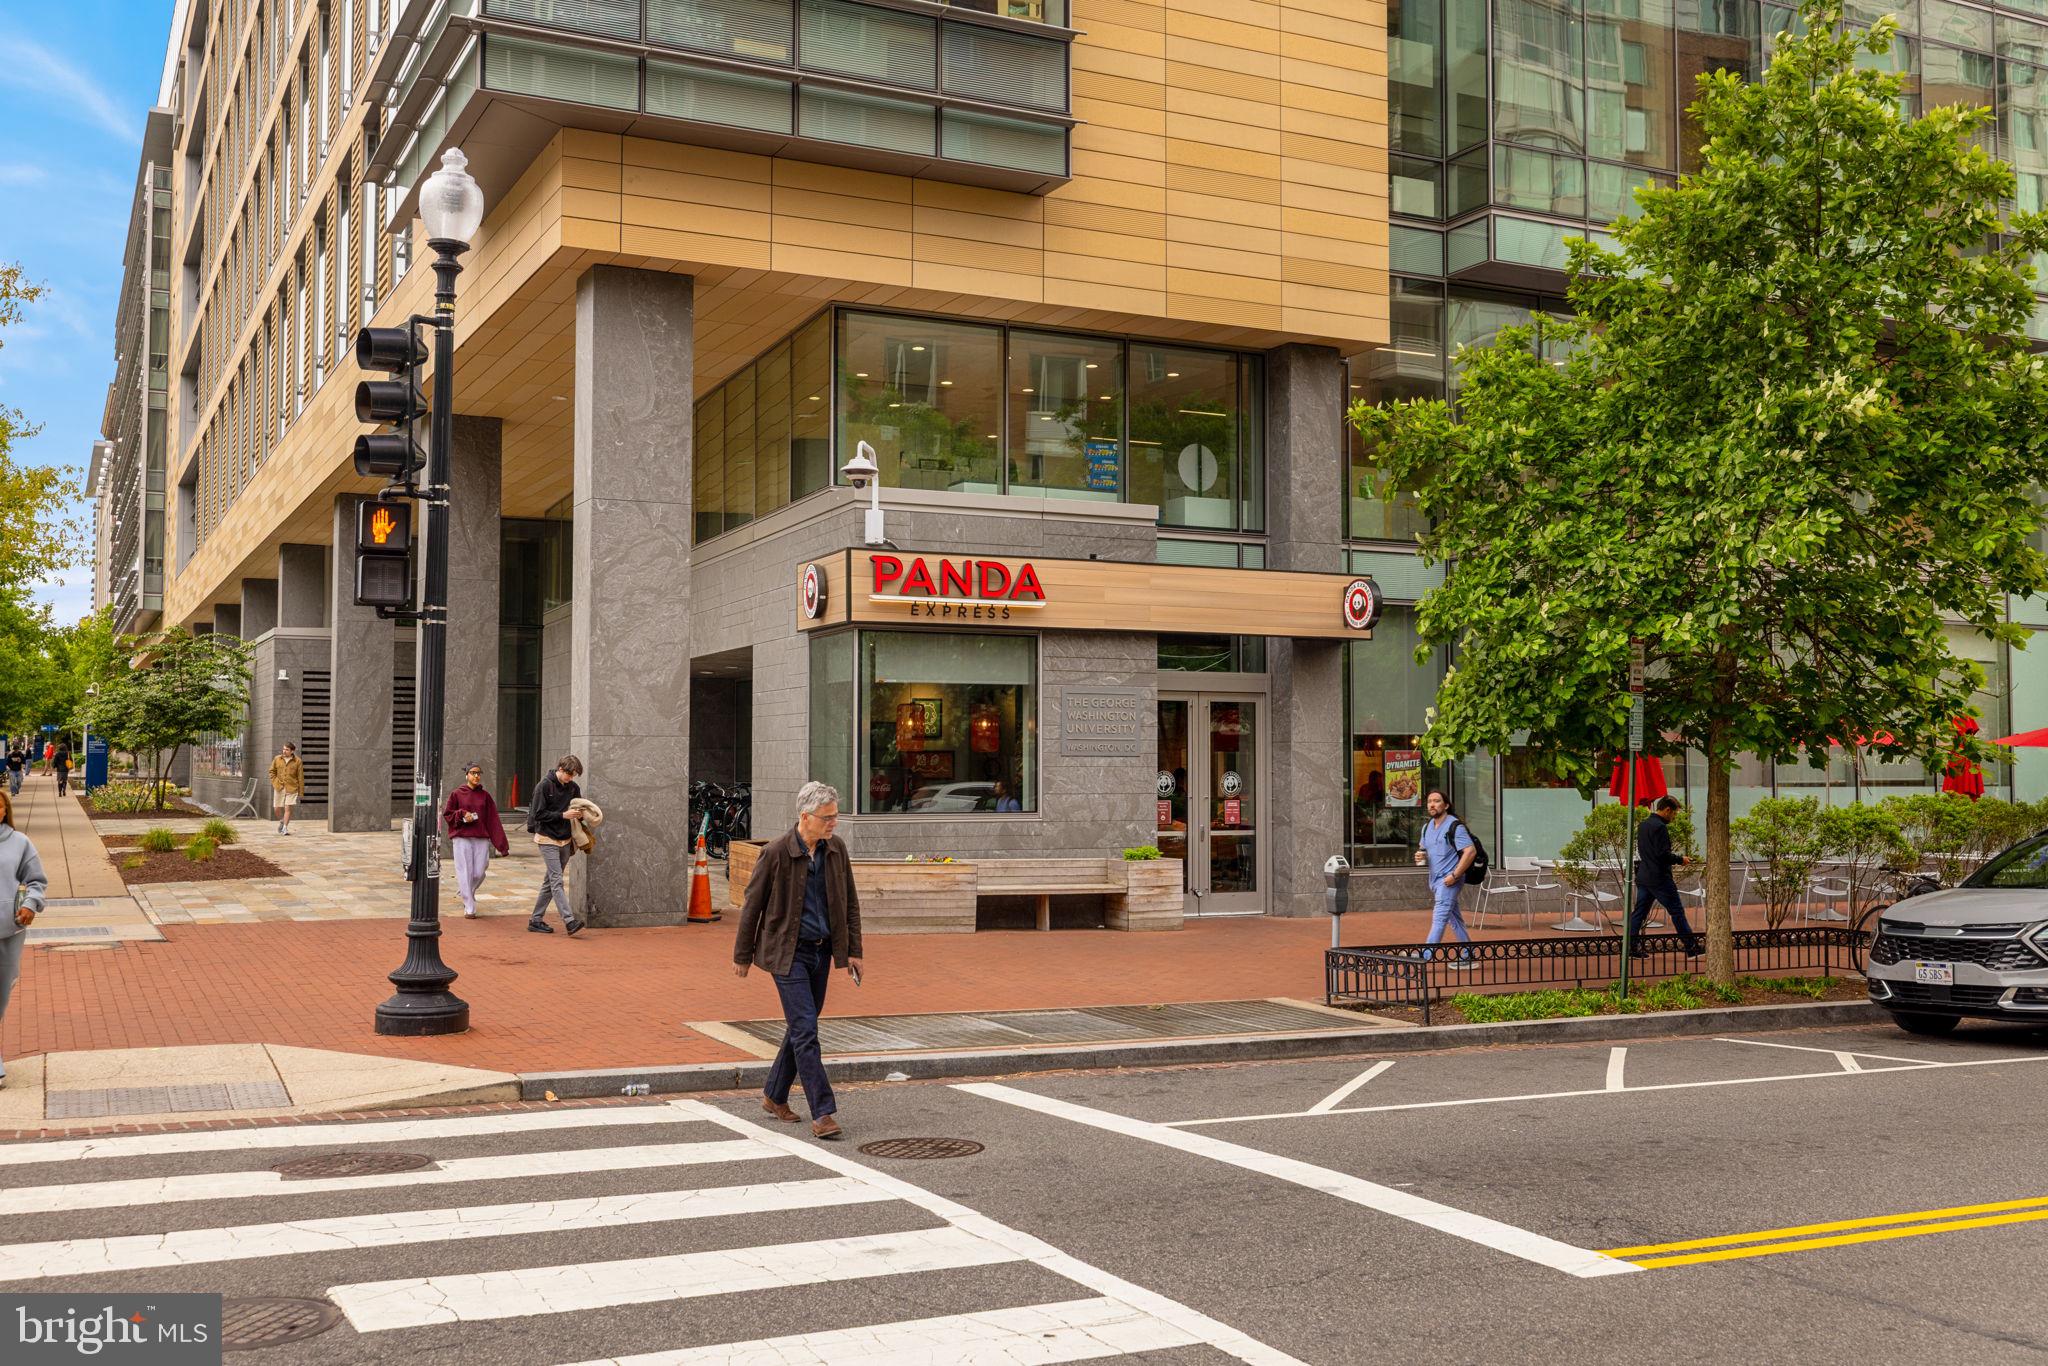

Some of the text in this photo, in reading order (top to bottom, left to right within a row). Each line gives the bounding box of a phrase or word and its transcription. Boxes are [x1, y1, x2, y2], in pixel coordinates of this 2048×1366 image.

[869, 555, 1046, 600] PANDA
[910, 602, 1010, 619] EXPRESS
[1066, 697, 1137, 708] THE GEORGE
[1066, 710, 1137, 721] WASHINGTON
[1066, 723, 1137, 735] UNIVERSITY
[1124, 743, 1136, 752] DC
[1386, 760, 1421, 770] DYNAMITE
